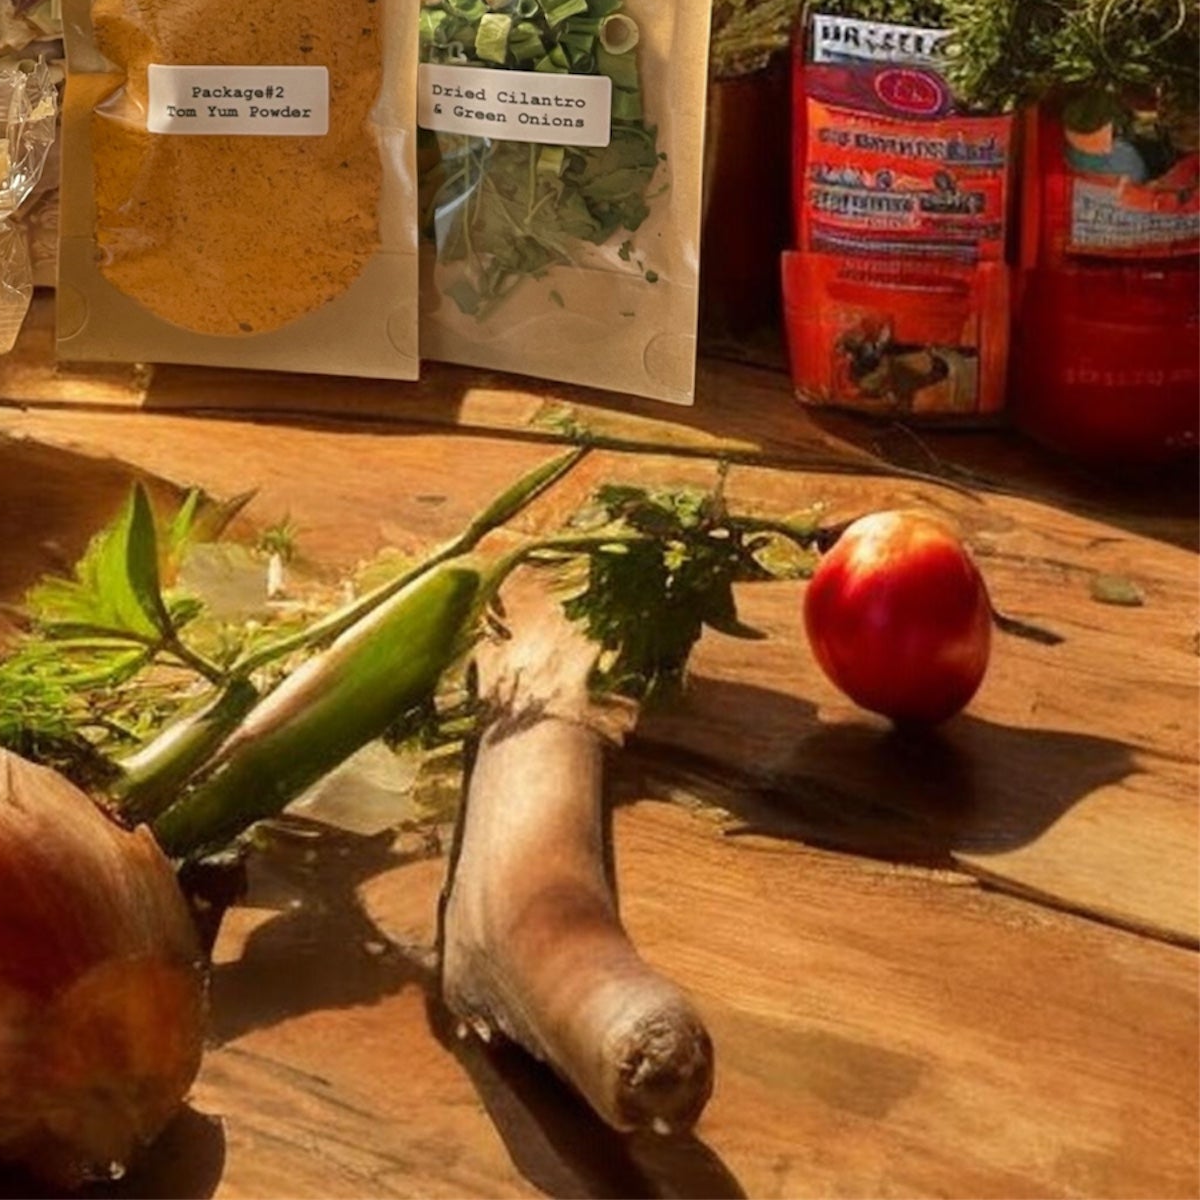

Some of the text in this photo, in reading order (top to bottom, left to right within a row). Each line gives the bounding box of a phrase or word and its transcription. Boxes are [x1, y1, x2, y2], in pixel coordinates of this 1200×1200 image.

[191, 86, 285, 100] Package#2
[432, 84, 586, 109] Dried Cilantro
[167, 106, 312, 118] Tom Yum Powder
[433, 104, 585, 128] & Green Onions
